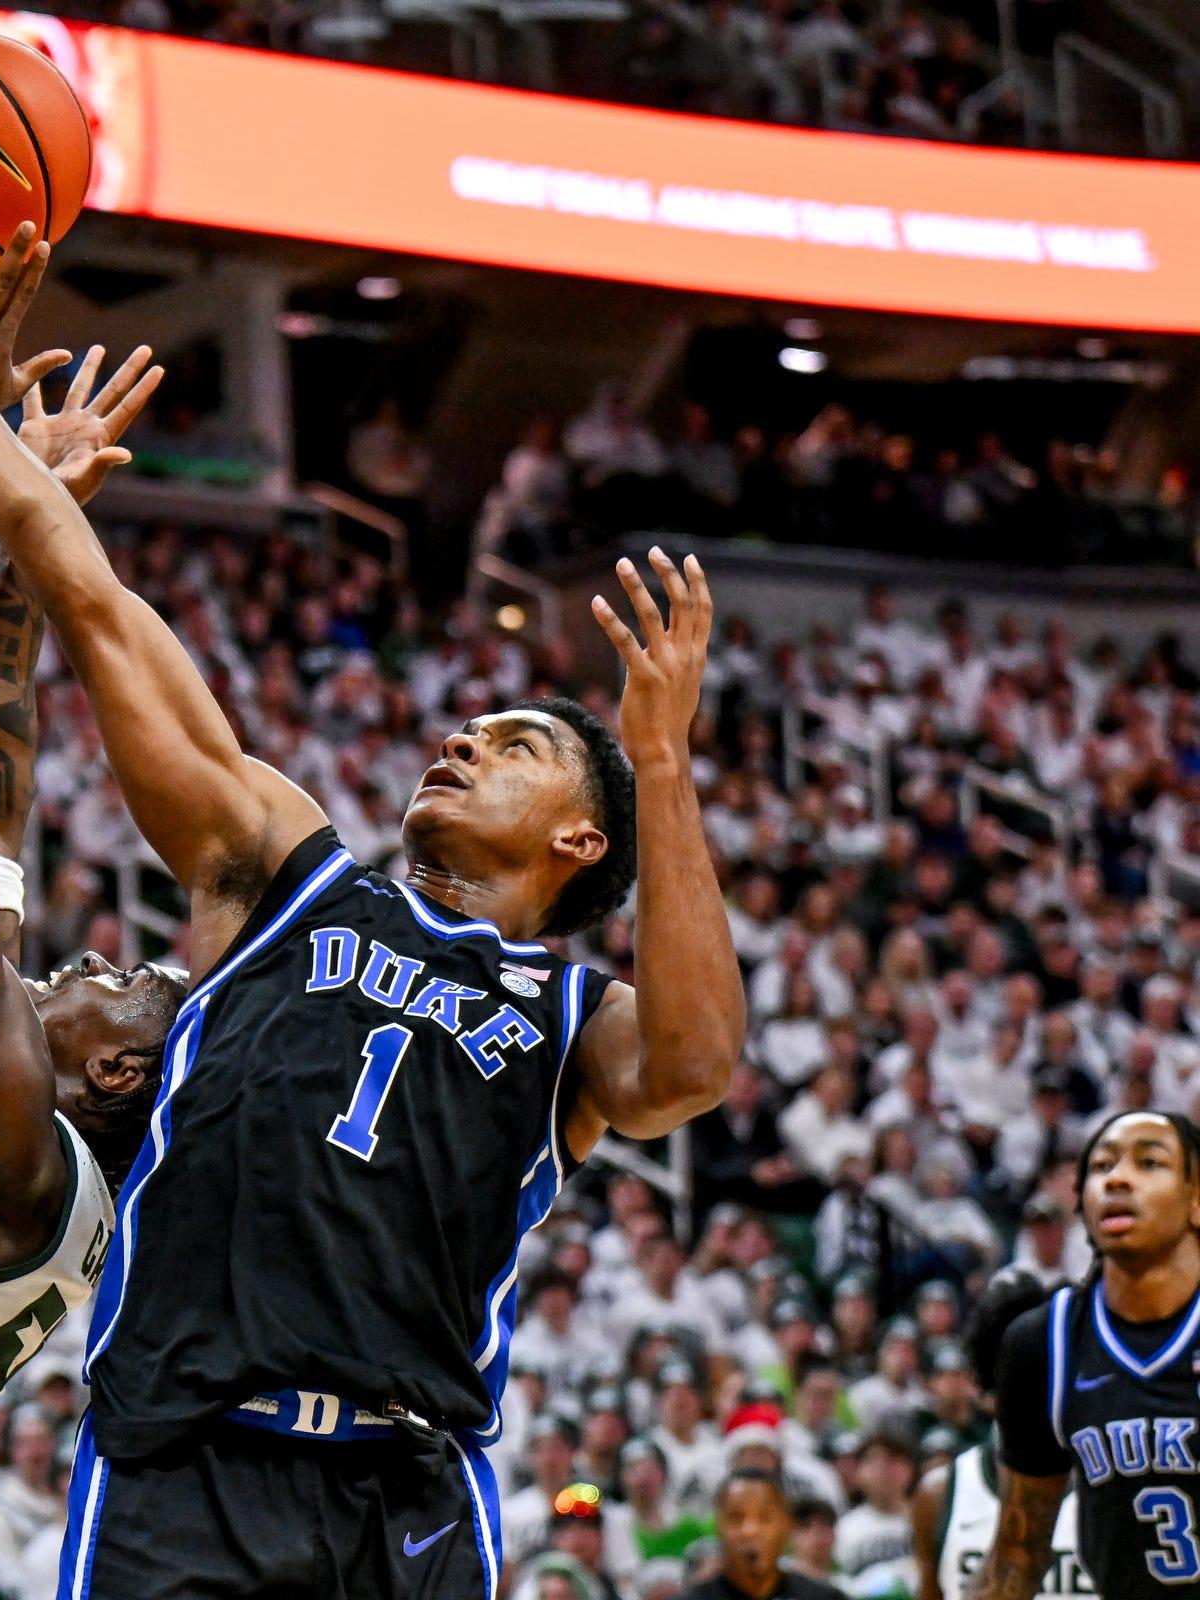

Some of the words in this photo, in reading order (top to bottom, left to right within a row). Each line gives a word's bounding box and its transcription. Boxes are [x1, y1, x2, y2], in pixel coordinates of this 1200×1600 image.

[305, 927, 545, 1081] DUKE
[326, 1022, 414, 1162] 1
[1069, 1416, 1200, 1488] DUK
[1133, 1485, 1200, 1585] 3
